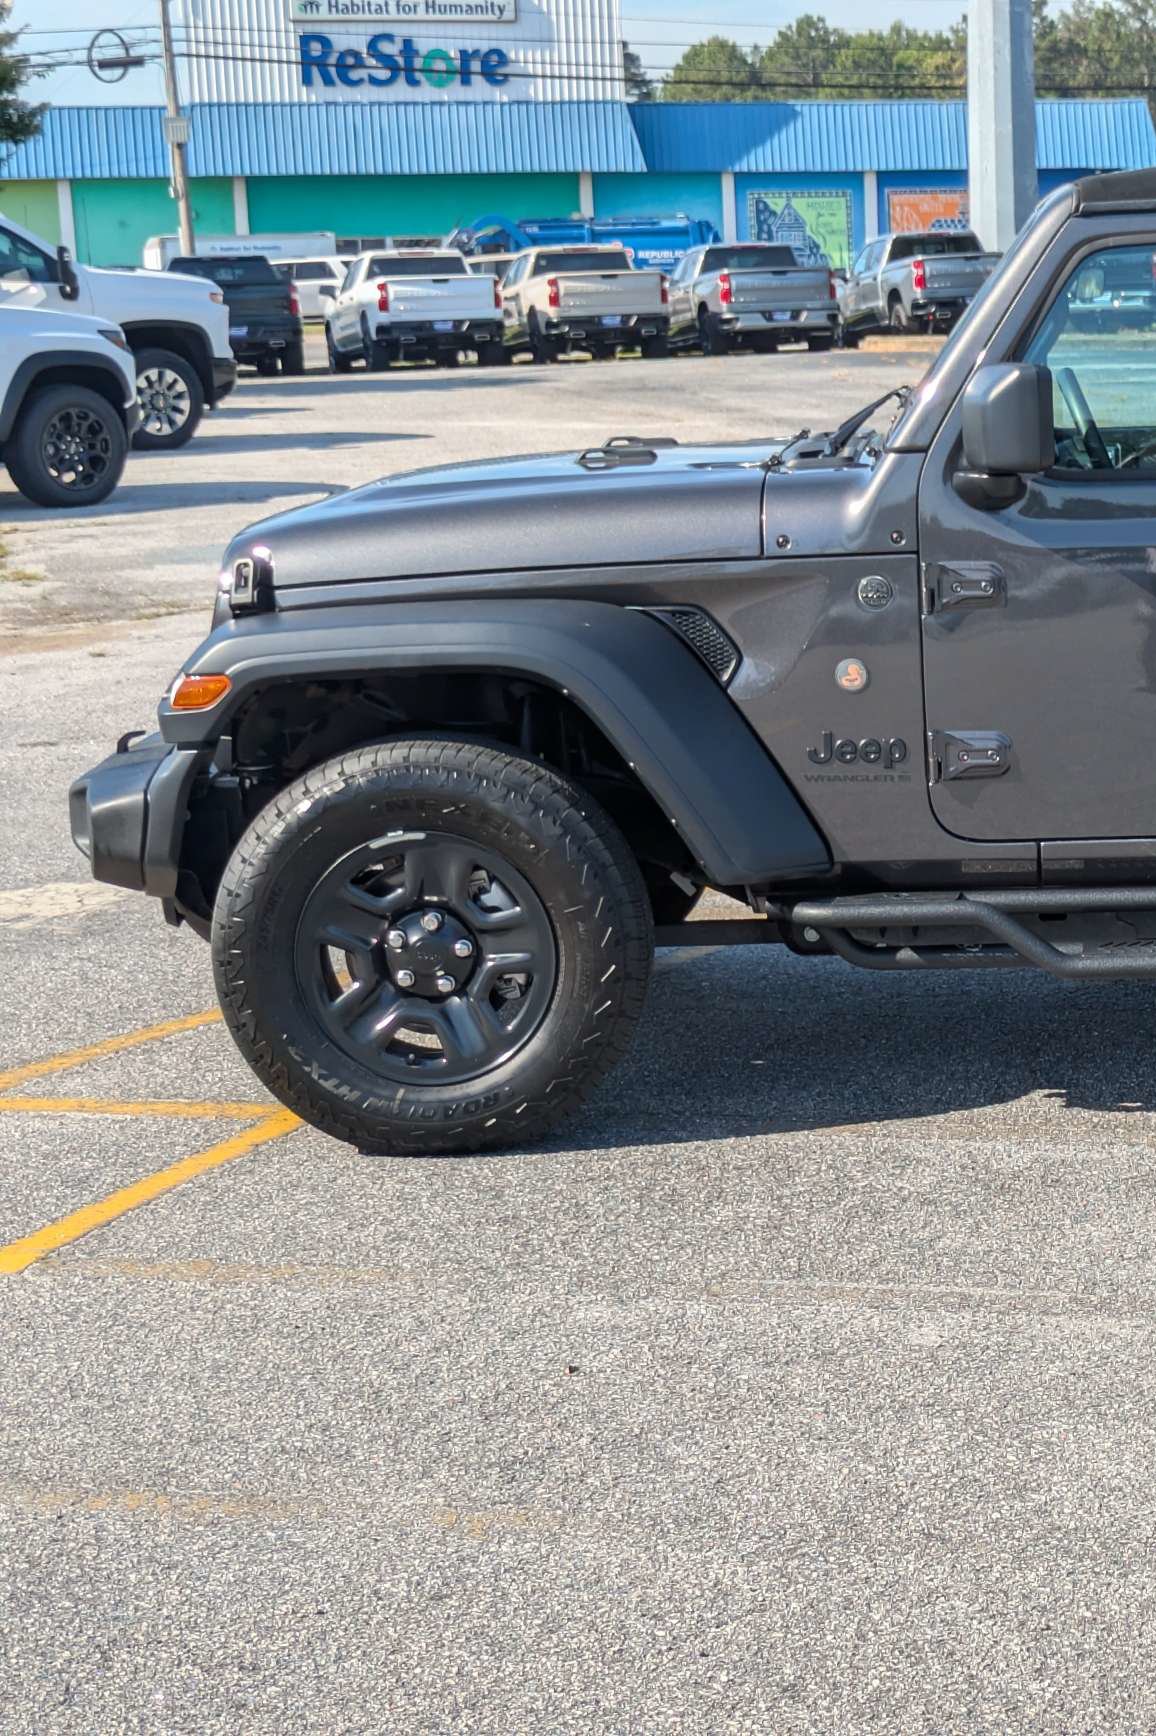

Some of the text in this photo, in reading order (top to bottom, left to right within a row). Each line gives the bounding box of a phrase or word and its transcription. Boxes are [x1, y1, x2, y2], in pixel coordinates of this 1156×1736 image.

[328, 0, 506, 19] Habitat for Humanity
[299, 32, 510, 89] ReStore
[806, 730, 907, 769] Jeep
